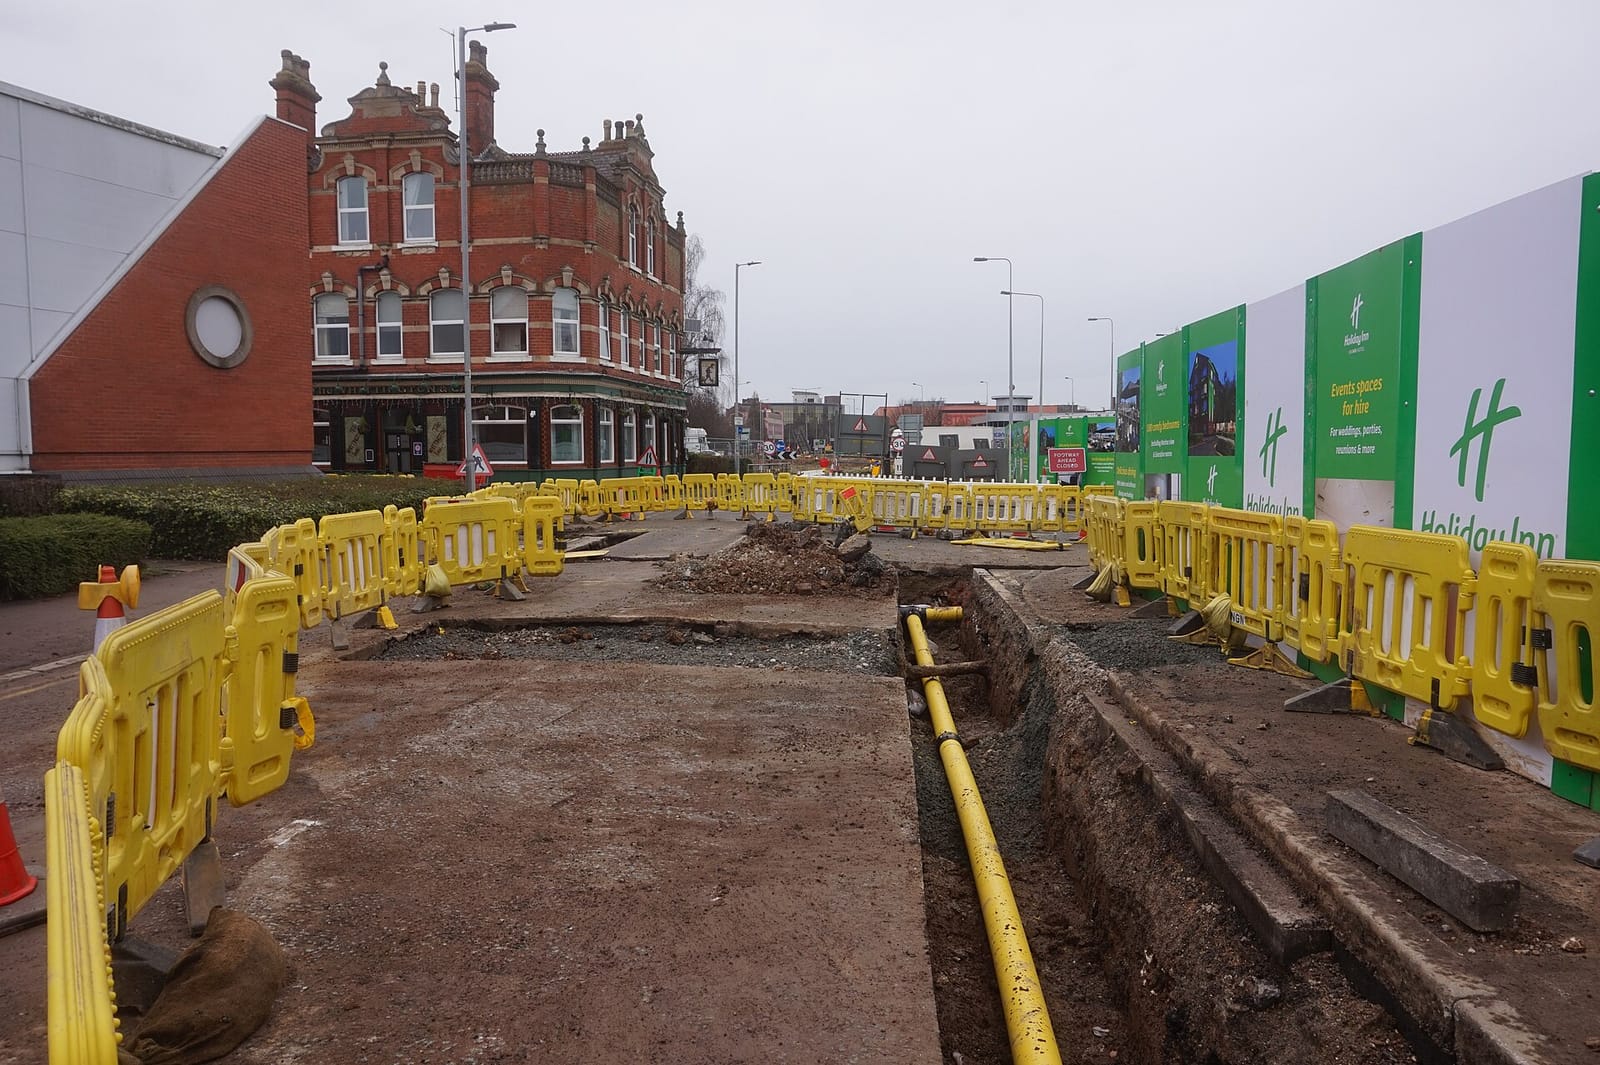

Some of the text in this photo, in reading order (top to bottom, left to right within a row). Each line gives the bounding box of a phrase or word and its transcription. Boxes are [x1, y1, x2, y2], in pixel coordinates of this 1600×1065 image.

[1344, 332, 1361, 347] Holiday
[1331, 378, 1383, 398] Events spaces
[1343, 399, 1370, 416] for hire
[1330, 423, 1383, 438] For weddings, parties,
[1336, 444, 1357, 455] reunions
[1362, 445, 1375, 454] more
[1230, 612, 1245, 625] NGN
